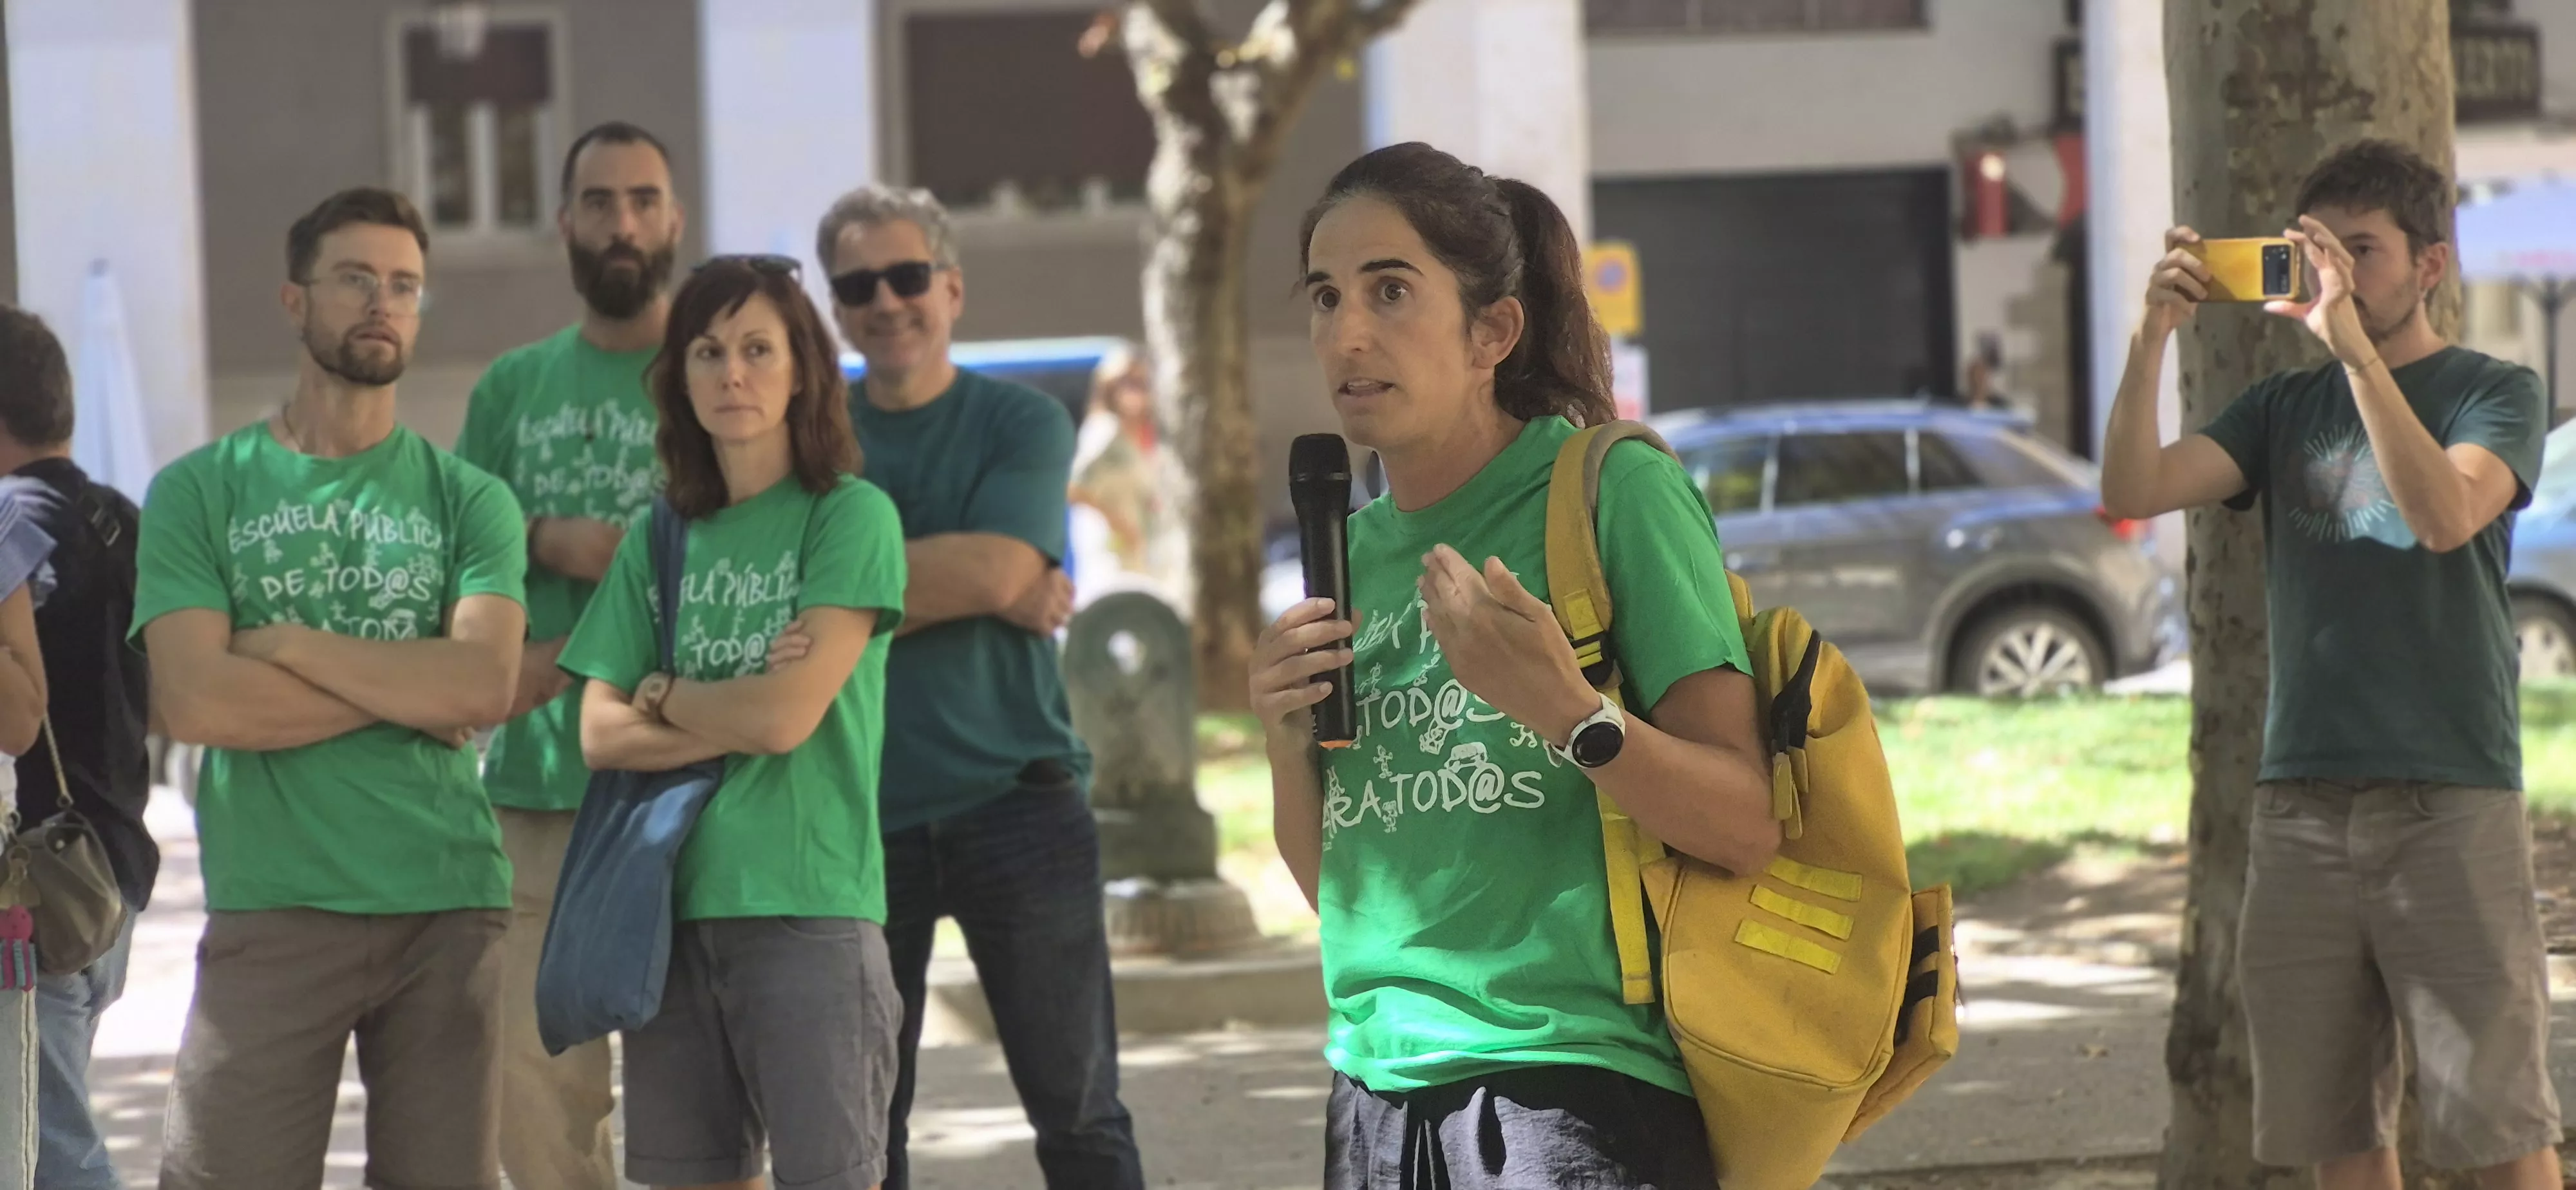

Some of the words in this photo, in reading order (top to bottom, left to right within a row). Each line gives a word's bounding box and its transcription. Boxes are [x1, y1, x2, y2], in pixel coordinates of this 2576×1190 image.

[228, 504, 342, 554] ESCUELA
[261, 568, 305, 601] DE
[322, 566, 432, 601] TOD@S
[1390, 762, 1545, 814] TOD@S
